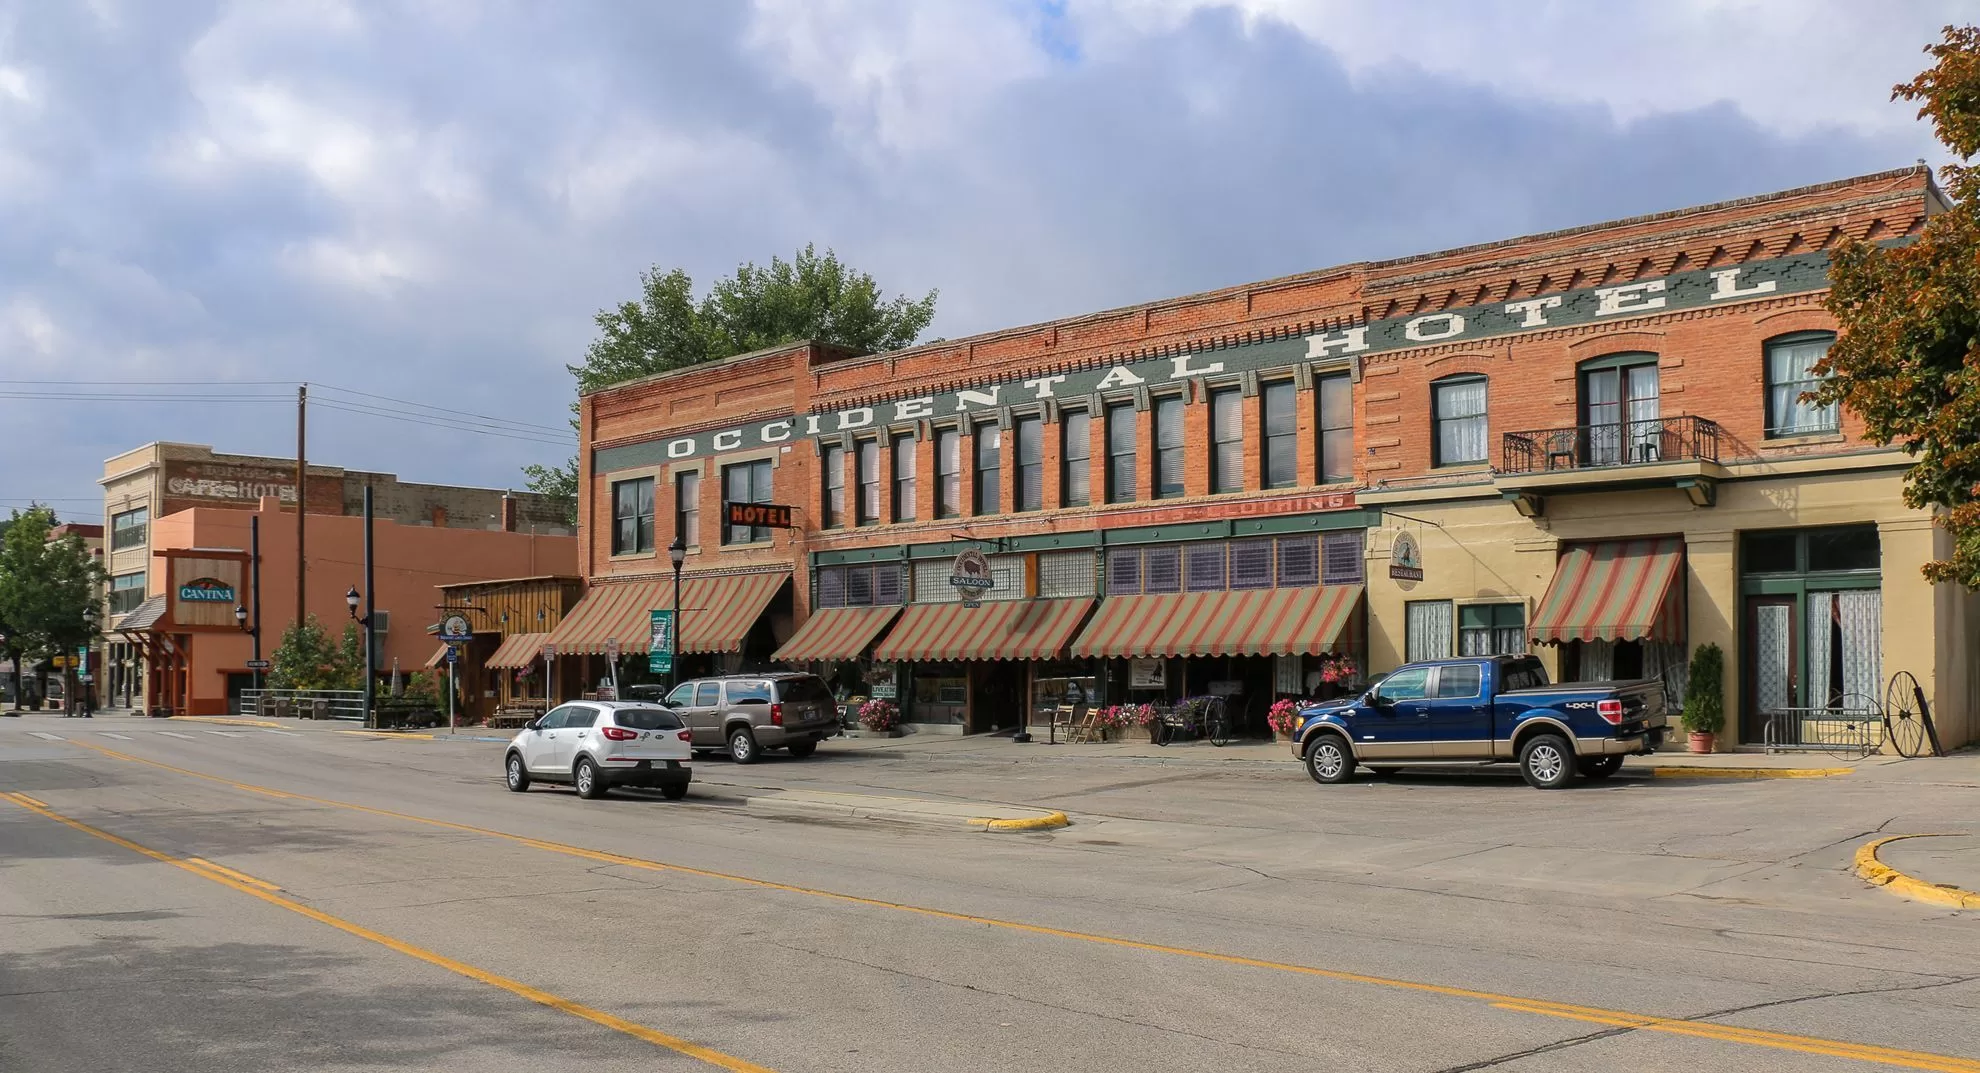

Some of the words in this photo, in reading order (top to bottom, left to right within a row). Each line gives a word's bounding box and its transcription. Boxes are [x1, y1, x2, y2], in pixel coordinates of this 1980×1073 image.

[667, 354, 1225, 459] OCCIDENTAL
[1304, 267, 1777, 359] HOTEL
[731, 505, 790, 525] HOTEL
[953, 577, 991, 586] SALOON
[181, 588, 233, 600] CANTINA
